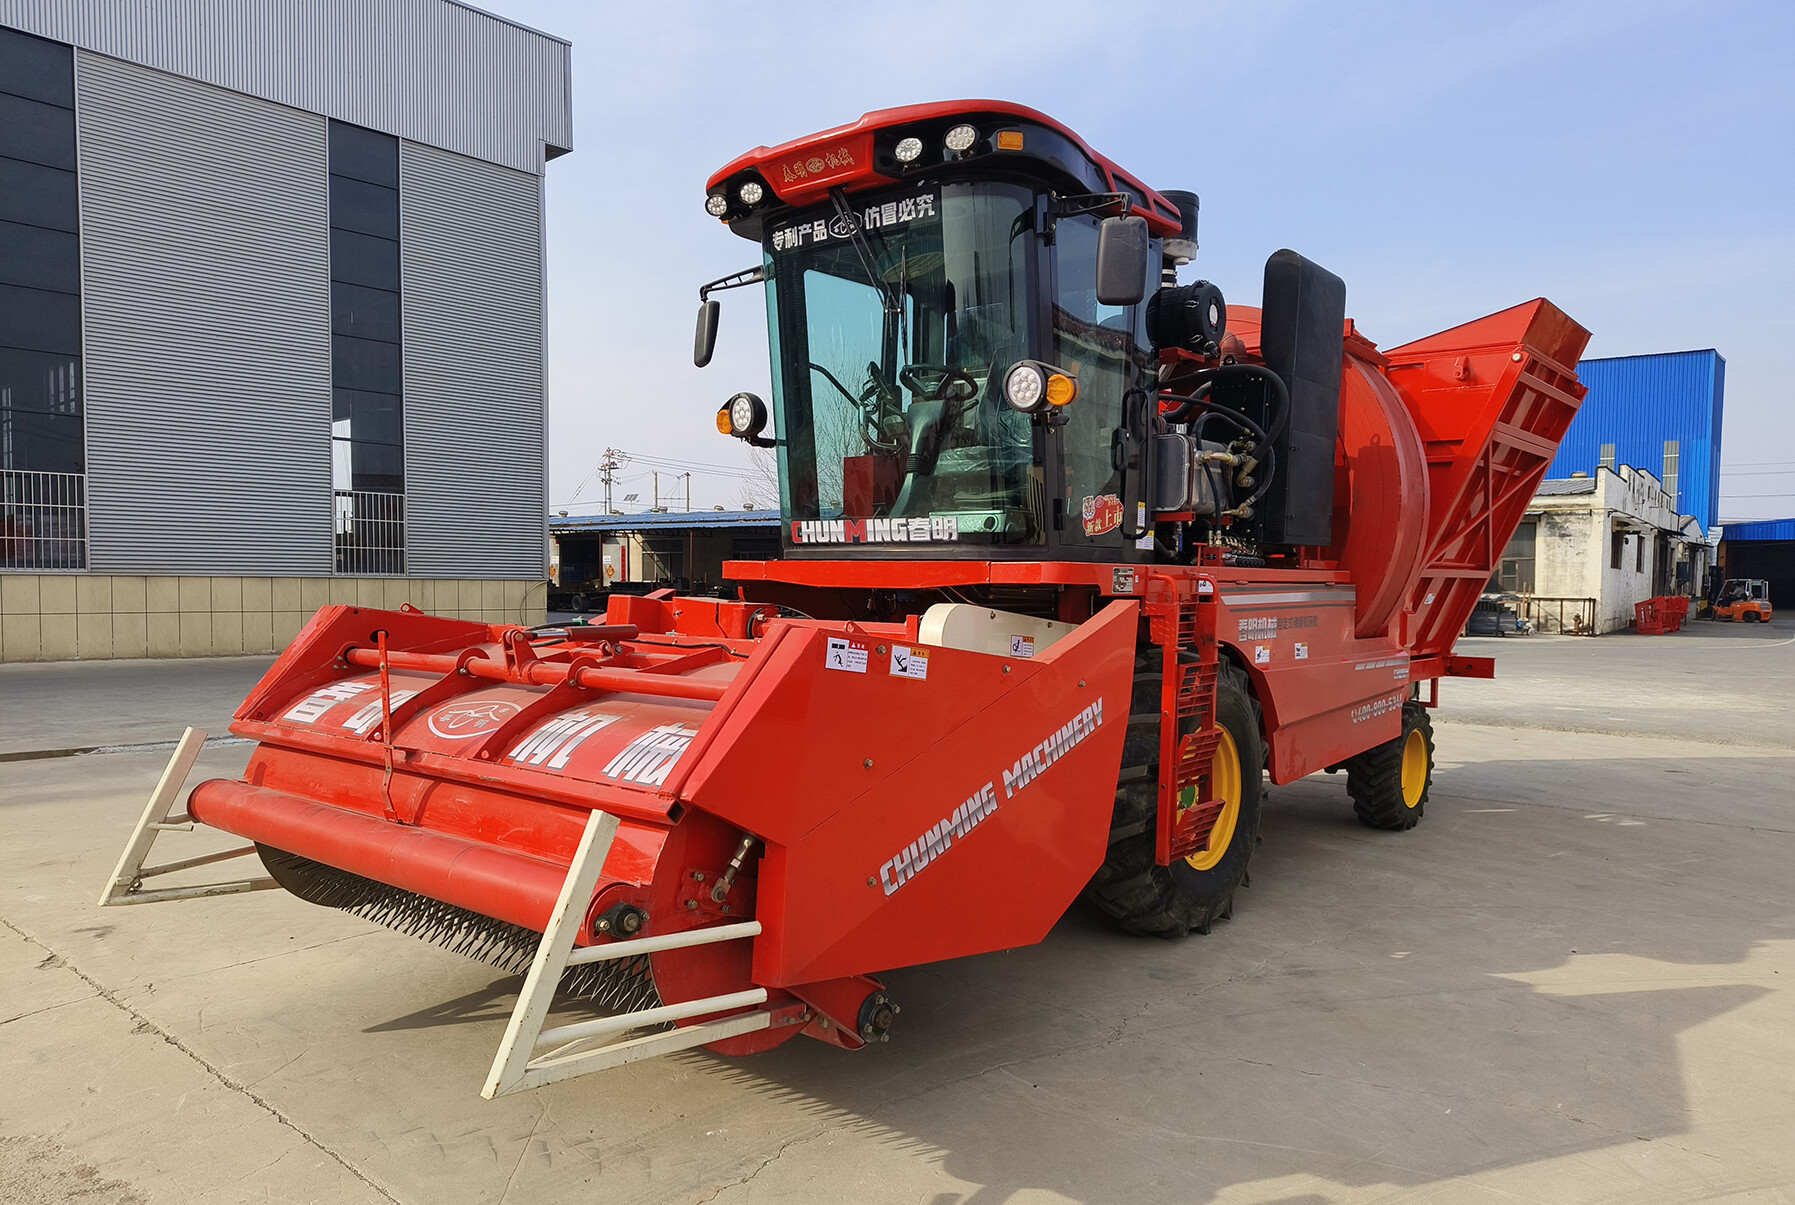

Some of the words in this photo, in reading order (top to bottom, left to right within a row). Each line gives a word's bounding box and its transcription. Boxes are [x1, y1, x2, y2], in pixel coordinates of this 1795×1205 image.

[772, 219, 828, 252] 专利产品
[864, 194, 936, 230] 仿冒必究
[1087, 505, 1124, 535] 新款上市
[1238, 616, 1278, 642] 春明机械
[879, 781, 998, 897] CHUNMING
[1002, 696, 1104, 800] MACHINERY
